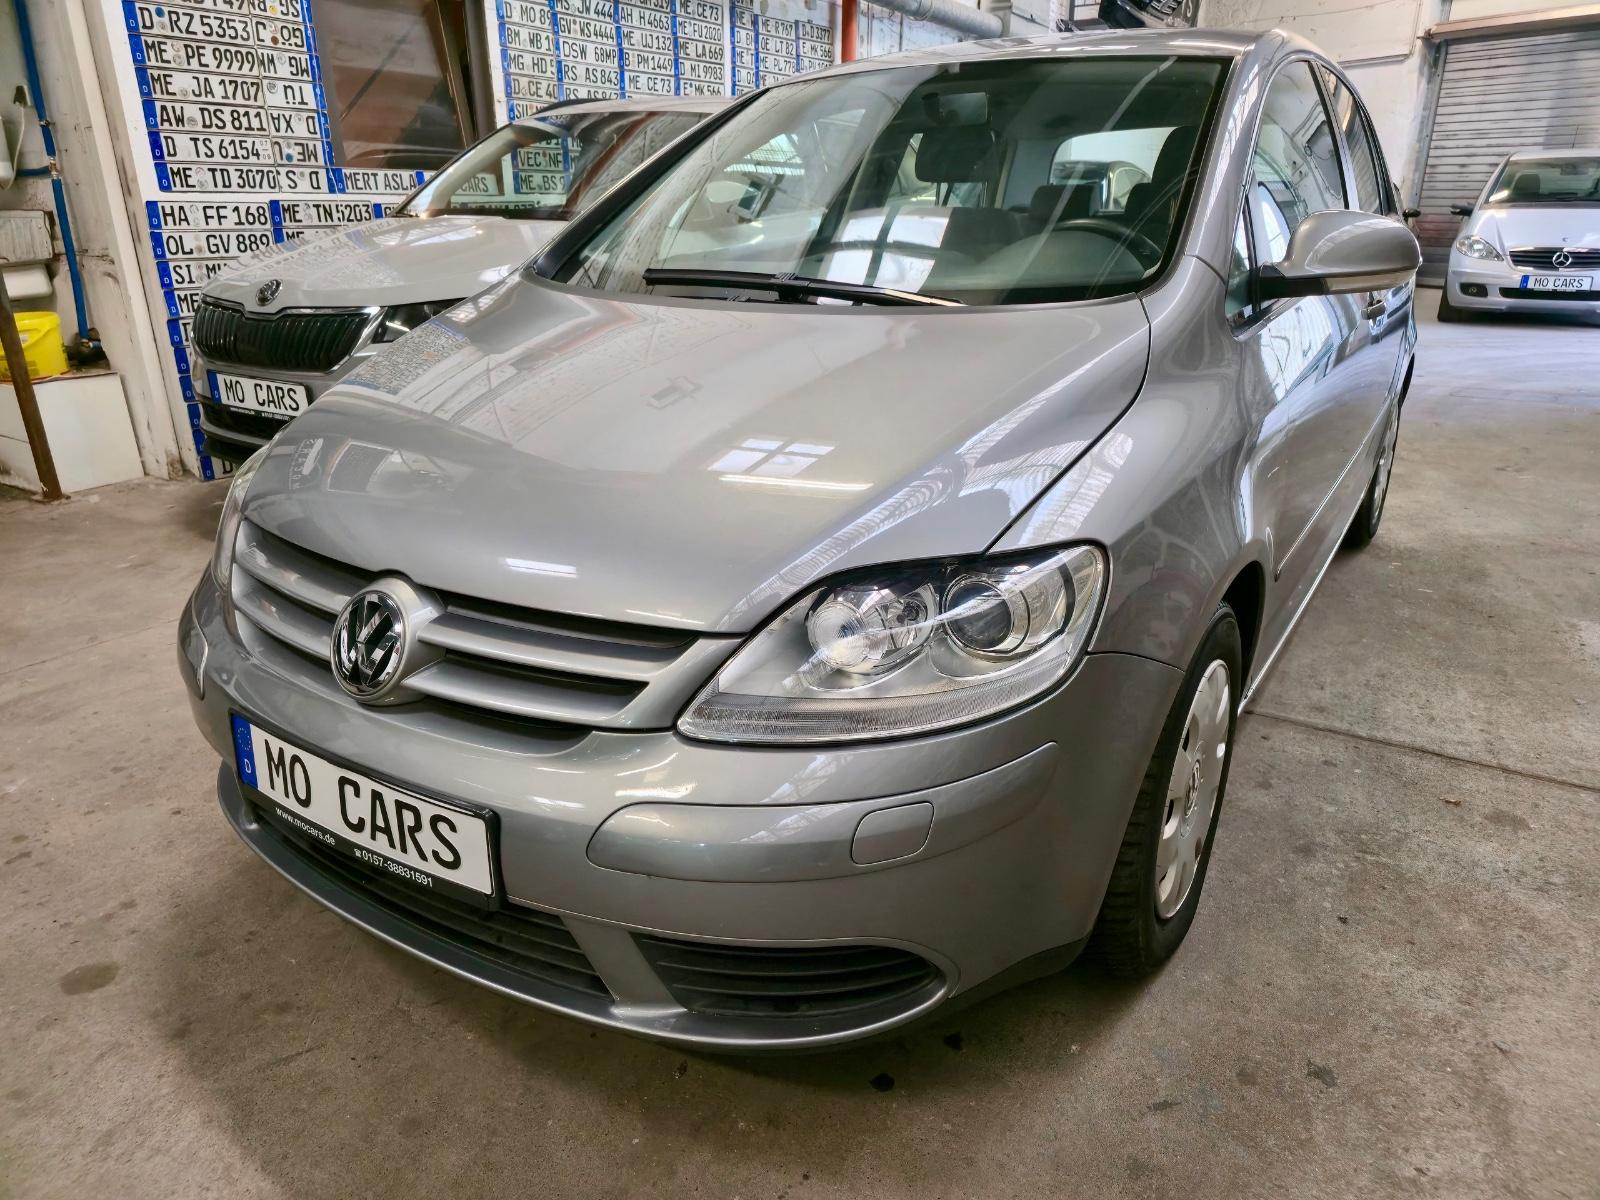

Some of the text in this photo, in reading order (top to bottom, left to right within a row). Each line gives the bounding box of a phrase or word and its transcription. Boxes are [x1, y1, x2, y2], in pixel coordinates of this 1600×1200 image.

[504, 1, 512, 19] D
[520, 4, 536, 23] MO
[639, 10, 646, 26] H
[648, 13, 670, 31] 4663
[697, 2, 707, 19] CE
[709, 5, 719, 21] 73
[138, 7, 154, 29] D
[168, 10, 197, 35] RZ
[200, 15, 250, 41] 5353
[560, 17, 615, 43] GV WS 4444
[678, 20, 721, 42] ME FU 2020
[506, 27, 542, 50] BM WB
[622, 30, 635, 46] ME
[656, 35, 672, 52] 132
[786, 42, 794, 56] 82
[144, 39, 171, 64] ME
[184, 44, 209, 68] PE
[212, 48, 256, 72] 9999
[562, 40, 617, 65] DSW 68MP
[680, 40, 724, 61] ME LA 669
[508, 52, 548, 74] MG HD
[624, 52, 672, 72] B PM 1449
[680, 62, 685, 76] D
[703, 64, 722, 80] 9983
[564, 64, 618, 86] RS AS 843
[628, 75, 671, 94] ME CE 73
[150, 72, 176, 96] ME
[192, 76, 215, 98] JA
[219, 79, 260, 102] 1707
[512, 78, 520, 95] D
[528, 80, 544, 98] CE
[160, 105, 185, 128] AW
[199, 107, 226, 129] DS
[230, 108, 267, 132] 811
[164, 136, 178, 157] D
[190, 137, 214, 158] TS
[219, 139, 261, 160] 6154
[518, 151, 541, 167] VEC
[170, 166, 196, 188] ME
[208, 168, 232, 188] TD
[234, 169, 277, 190] 3070
[344, 172, 378, 190] MERT
[384, 172, 416, 192] ASLA
[520, 174, 536, 190] ME
[542, 176, 558, 190] BS
[161, 205, 190, 226] HA
[202, 206, 228, 226] FF
[232, 206, 268, 226] 168
[282, 204, 302, 223] ME
[313, 204, 334, 223] TN
[336, 204, 372, 222] 5203
[166, 235, 194, 256] OL
[206, 234, 230, 254] GV
[236, 233, 270, 253] 889
[172, 264, 195, 285] SI
[1533, 277, 1584, 289] MO CARS
[223, 378, 300, 412] MO CARS
[244, 738, 462, 871] D MO CARS
[275, 806, 336, 847] www.mocars.de
[362, 849, 434, 888] 0157-38831591
